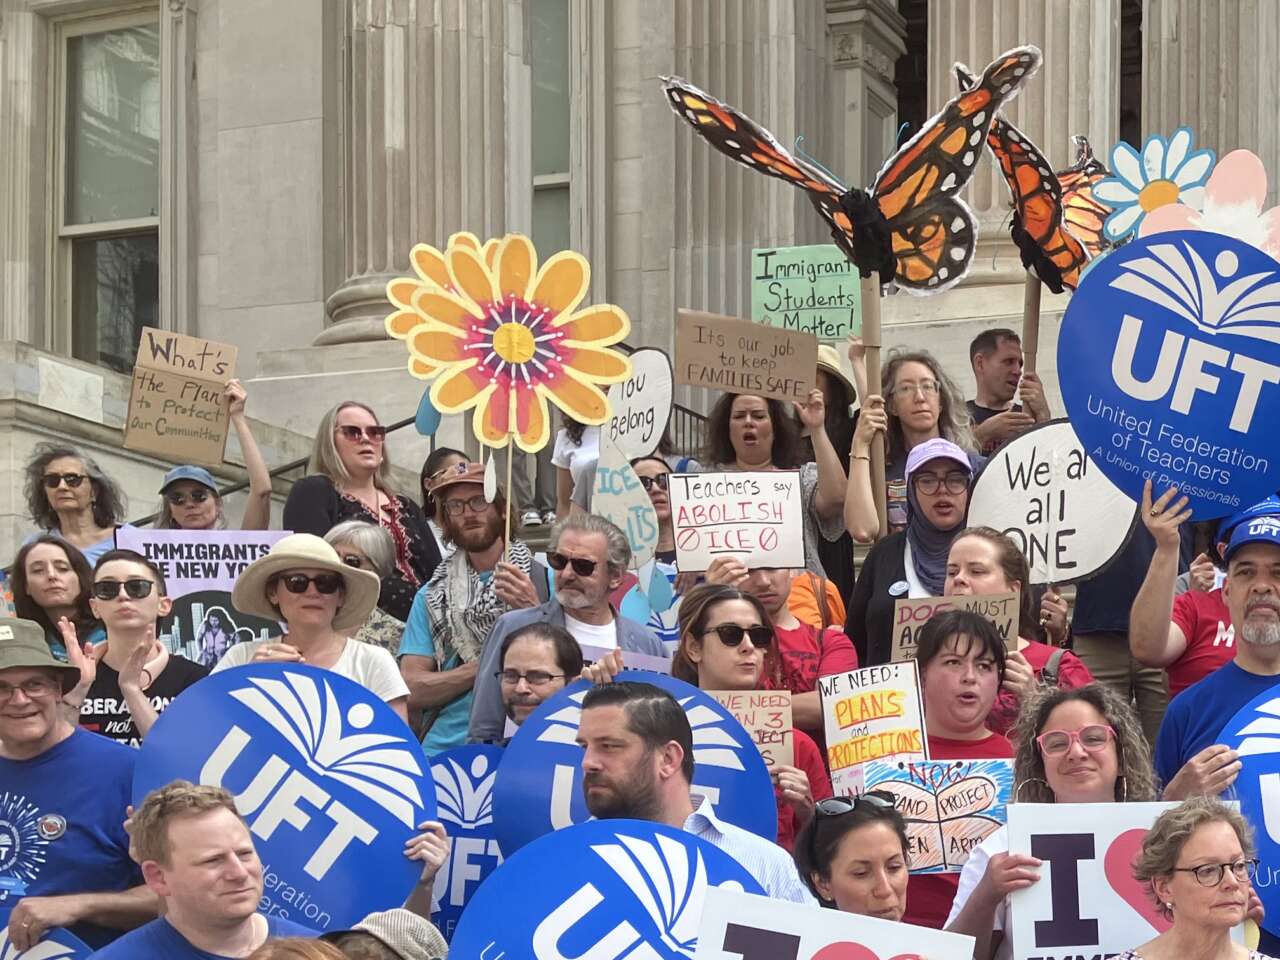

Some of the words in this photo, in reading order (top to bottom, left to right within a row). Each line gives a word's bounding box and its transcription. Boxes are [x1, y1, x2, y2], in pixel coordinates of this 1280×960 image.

[763, 281, 854, 312] Students
[146, 331, 229, 376] What's
[719, 352, 736, 367] to
[741, 354, 777, 375] keep
[770, 338, 795, 359] job
[136, 371, 167, 394] the
[687, 363, 762, 391] FAMILIES
[766, 376, 807, 397] SAFE
[162, 399, 226, 423] Protect
[610, 406, 655, 444] Belong
[1086, 394, 1152, 438] United
[1158, 422, 1269, 473] Federation
[1005, 446, 1050, 491] We
[1111, 429, 1131, 449] of
[1137, 437, 1232, 486] Teachers
[598, 465, 641, 496] ICE
[672, 475, 761, 501] Teachers
[773, 481, 793, 499] say
[1105, 451, 1141, 475] Union
[1156, 475, 1241, 507] Professionals
[676, 501, 784, 526] ABOLISH
[705, 528, 755, 549] ICE
[1248, 525, 1280, 537] UFT
[142, 543, 271, 561] IMMIGRANTS
[176, 562, 219, 579] NEW
[749, 695, 791, 709] NEED
[819, 676, 842, 698] WE
[835, 691, 902, 727] PLANS
[104, 716, 132, 734] not
[753, 729, 794, 746] JECT
[828, 729, 923, 769] PROTECTIONS
[200, 725, 379, 882] UFT
[940, 783, 988, 816] PROJECT
[260, 864, 331, 929] eration
[1030, 833, 1100, 948] I
